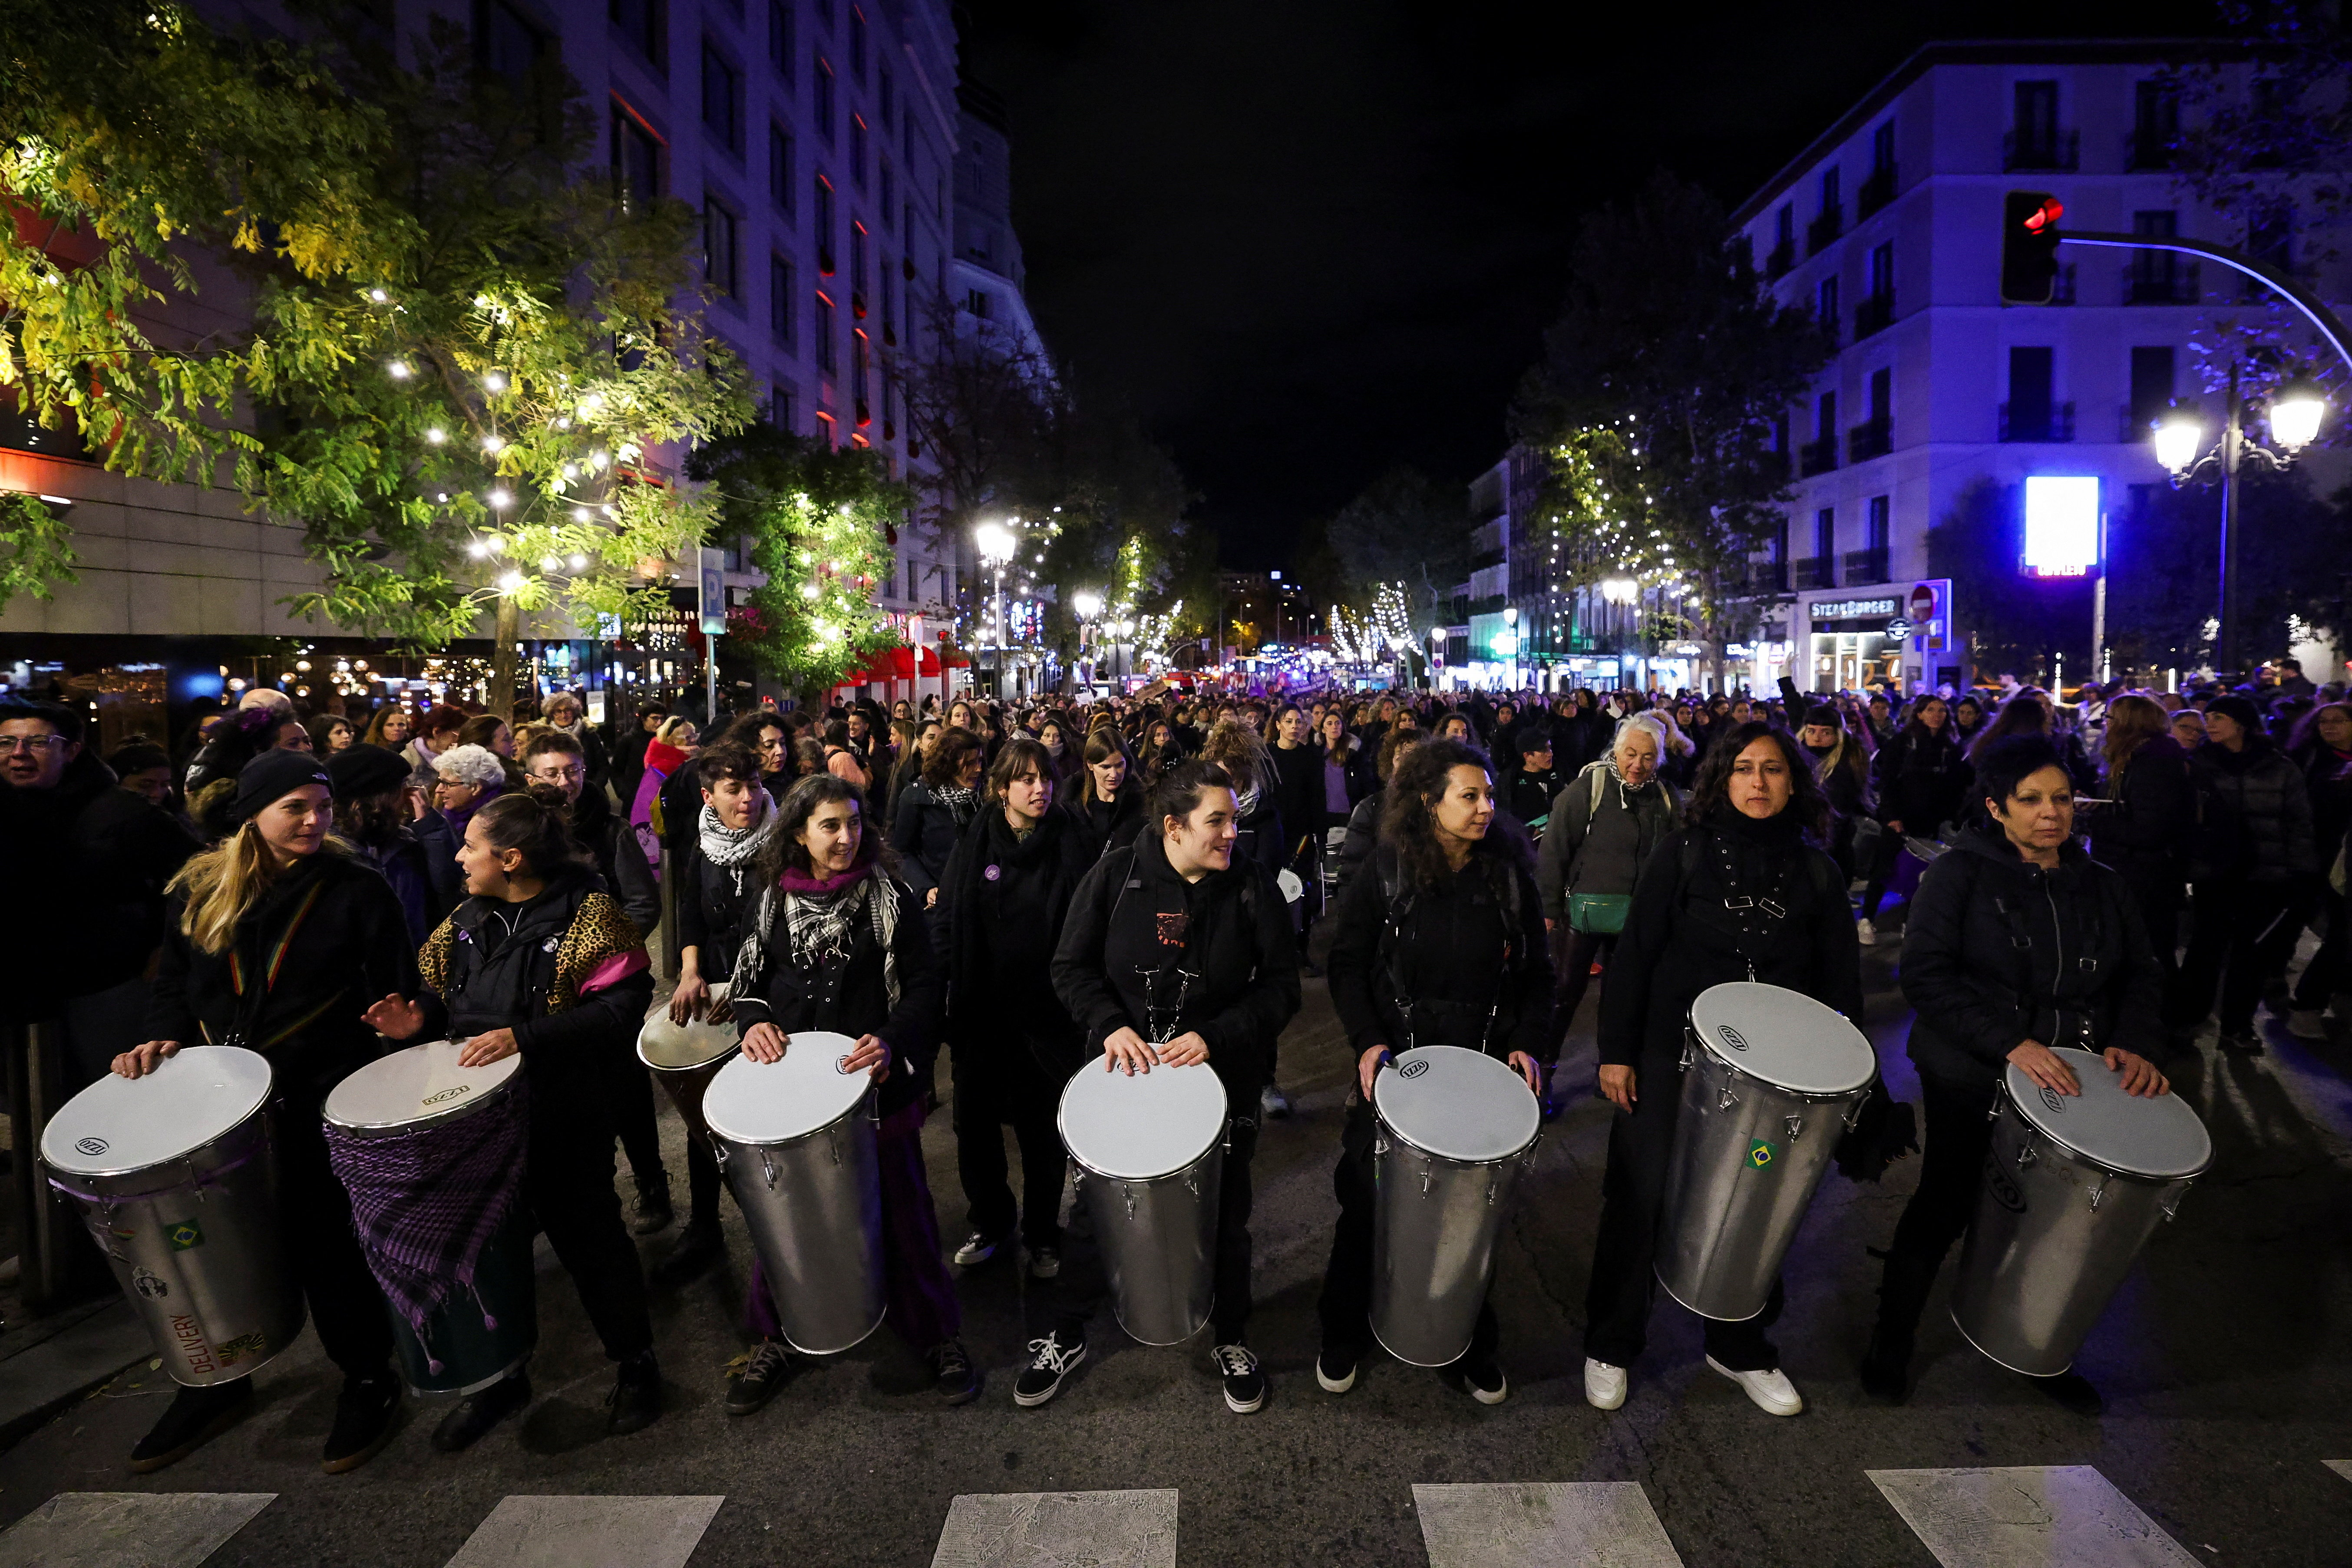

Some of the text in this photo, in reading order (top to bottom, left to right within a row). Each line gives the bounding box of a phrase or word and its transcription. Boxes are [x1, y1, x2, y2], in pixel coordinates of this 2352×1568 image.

[1721, 1028, 1746, 1048] IZZO
[1403, 1061, 1425, 1077] IZZO
[79, 1140, 106, 1153] IZZO
[169, 1315, 215, 1374] DELIVERY
